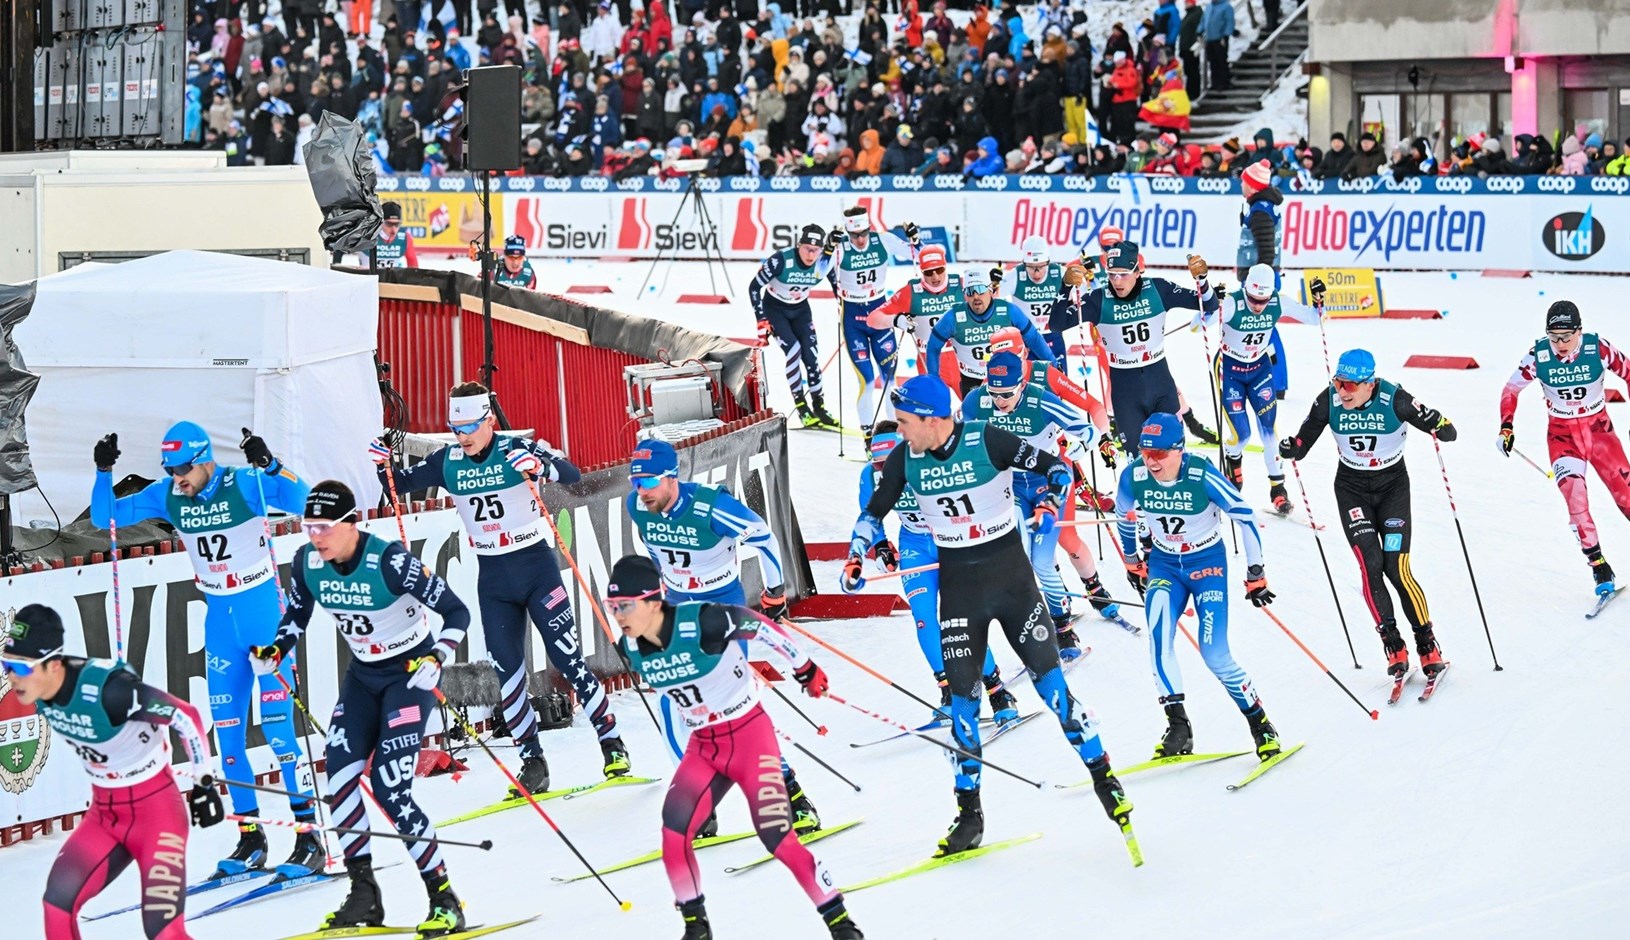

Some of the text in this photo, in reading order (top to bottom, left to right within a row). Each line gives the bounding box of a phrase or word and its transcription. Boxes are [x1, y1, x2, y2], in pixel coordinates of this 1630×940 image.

[406, 177, 430, 192] coop
[439, 177, 465, 192] coop
[508, 177, 535, 192] coop
[543, 177, 571, 192] coop
[580, 177, 608, 192] coop
[730, 177, 760, 192] coop
[770, 177, 800, 192] coop
[810, 177, 841, 193] coop
[893, 176, 924, 192] coop
[1019, 176, 1051, 192] coop
[1152, 178, 1185, 195] coop
[1197, 178, 1231, 194] coop
[1436, 177, 1472, 194] coop
[1486, 177, 1524, 194] coop
[1537, 177, 1575, 194] coop
[1591, 177, 1629, 194] coop
[547, 223, 606, 249] Sievi
[655, 224, 718, 250] Sievi
[1282, 200, 1486, 263] Autoexperten
[850, 252, 879, 262] POLAR
[850, 259, 881, 269] HOUSE
[856, 269, 877, 285] 54
[1327, 272, 1356, 286] 50m
[1024, 285, 1056, 294] POLAR
[1024, 292, 1057, 301] HOUSE
[921, 295, 955, 306] POLAR
[1113, 299, 1150, 313] POLAR
[1031, 303, 1052, 317] 52
[1114, 307, 1153, 321] HOUSE
[1239, 321, 1273, 330] HOUSE
[1241, 314, 1273, 323] POLAR
[1121, 321, 1150, 345] 56
[1241, 332, 1266, 345] 43
[1118, 357, 1139, 365] Sievi
[1548, 364, 1590, 376] POLAR
[1549, 373, 1592, 384] HOUSE
[1557, 387, 1588, 400] 59
[988, 417, 1032, 426] POLAR
[1339, 413, 1385, 423] POLAR
[1339, 422, 1386, 431] HOUSE
[1349, 436, 1377, 452] 57
[456, 463, 504, 480] POLAR
[919, 460, 975, 480] POLAR
[457, 474, 506, 491] HOUSE
[920, 474, 978, 492] HOUSE
[1143, 490, 1193, 502] POLAR
[180, 501, 230, 517] POLAR
[469, 493, 505, 522] 25
[936, 493, 977, 518] 31
[1143, 500, 1194, 512] HOUSE
[181, 513, 232, 529] HOUSE
[986, 517, 1013, 536] Sievi
[1155, 516, 1187, 535] 12
[514, 527, 540, 544] Sievi
[646, 521, 698, 537] POLAR
[475, 540, 496, 550] Sievi
[647, 532, 700, 547] HOUSE
[937, 533, 964, 543] Sievi
[196, 533, 232, 562] 42
[660, 548, 691, 568] 77
[242, 566, 269, 585] Sievi
[704, 570, 732, 585] Sievi
[1189, 566, 1224, 581] GRK
[319, 580, 372, 595] POLAR
[1202, 590, 1223, 598] INTER
[320, 593, 375, 607] HOUSE
[405, 605, 417, 618] 5
[332, 612, 375, 637] 53
[1018, 601, 1045, 644] evecon
[943, 647, 972, 660] silen
[641, 652, 693, 672] POLAR
[645, 663, 700, 684] HOUSE
[261, 692, 285, 702] enel
[667, 683, 705, 708] 67
[44, 706, 93, 728] POLAR
[49, 717, 98, 740] HOUSE
[381, 732, 421, 755] STIFEL
[758, 755, 791, 834] JAPAN
[144, 832, 185, 919] JAPAN
[322, 928, 360, 937] FISCHER
